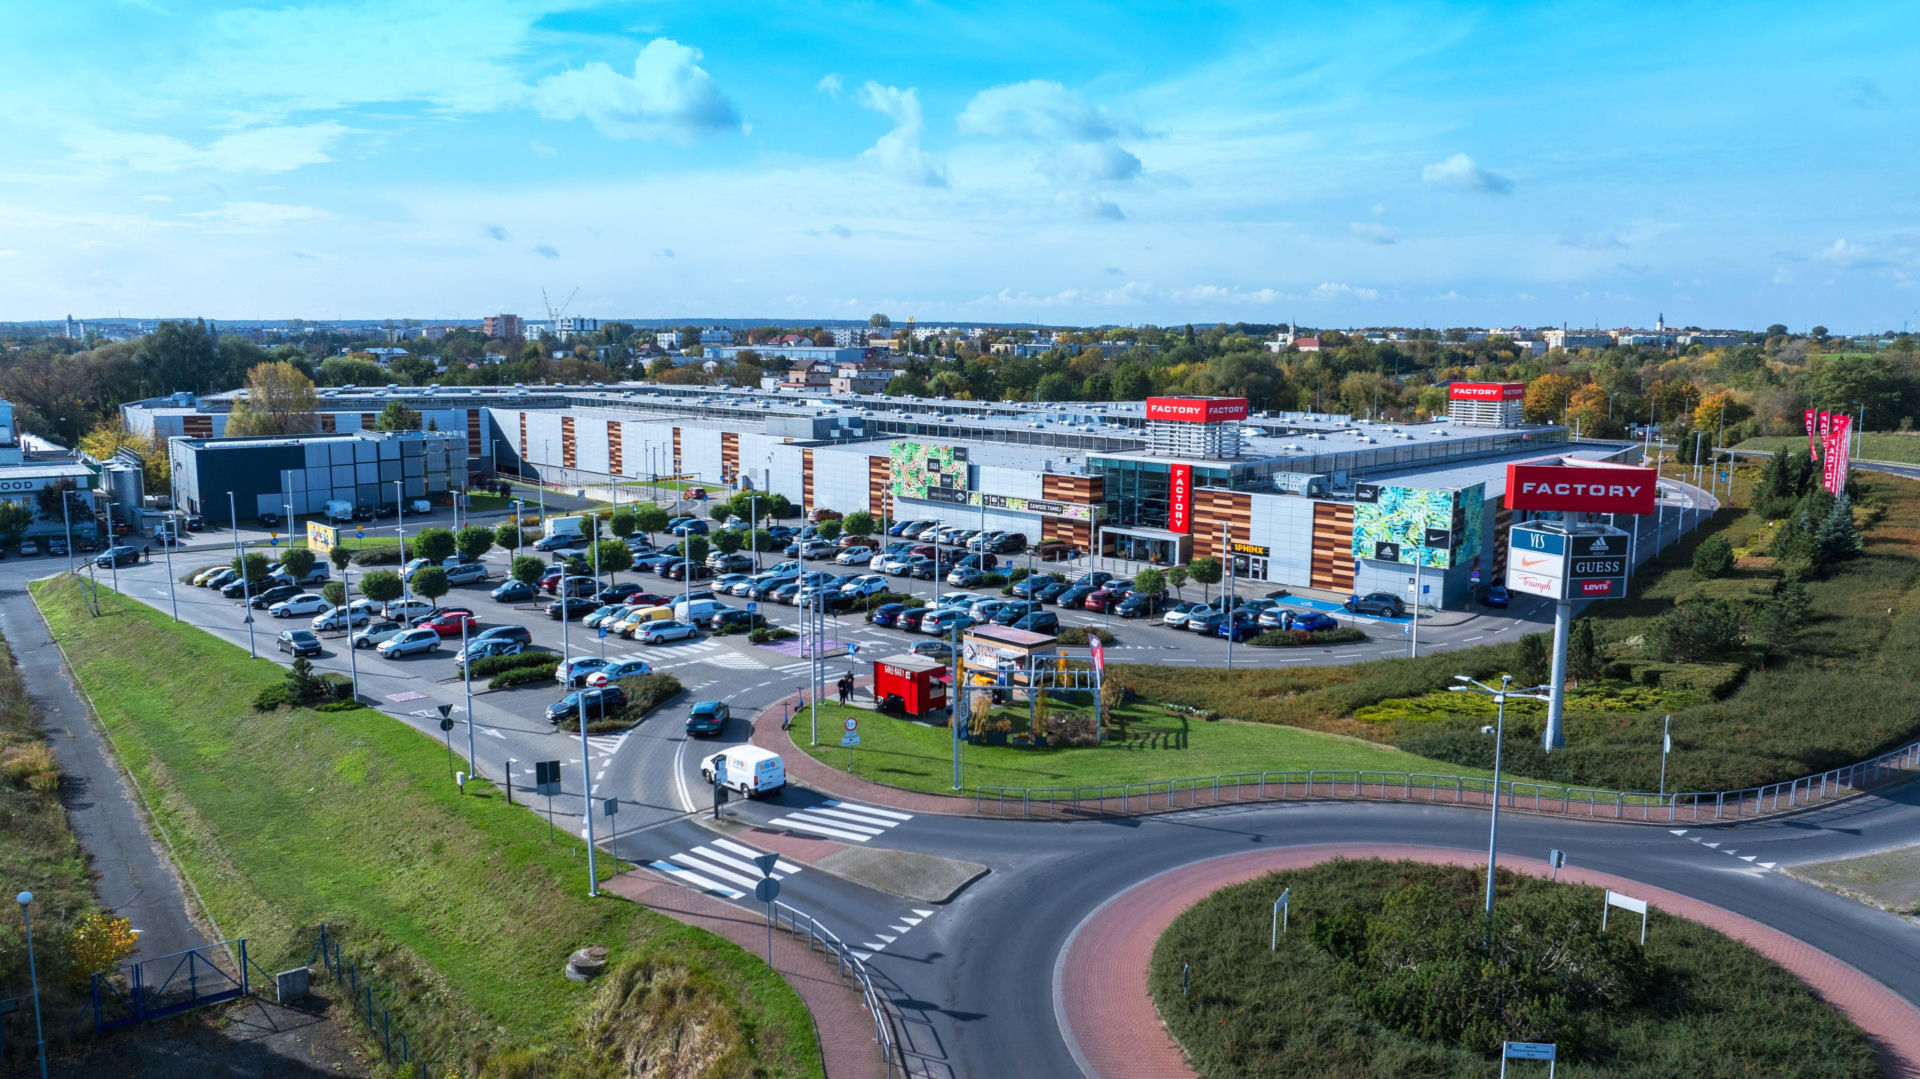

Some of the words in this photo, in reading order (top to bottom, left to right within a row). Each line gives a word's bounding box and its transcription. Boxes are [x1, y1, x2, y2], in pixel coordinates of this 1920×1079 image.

[1453, 388, 1498, 396] FACTORY
[1151, 405, 1201, 415] FACTORY
[1208, 405, 1244, 415] FACTORY
[1522, 482, 1642, 498] FACTORY
[1175, 469, 1184, 527] FACTORY
[1530, 533, 1545, 549] YES
[1234, 543, 1264, 555] SPHINX
[1576, 561, 1620, 573] GUESS
[1518, 574, 1552, 592] Triumph
